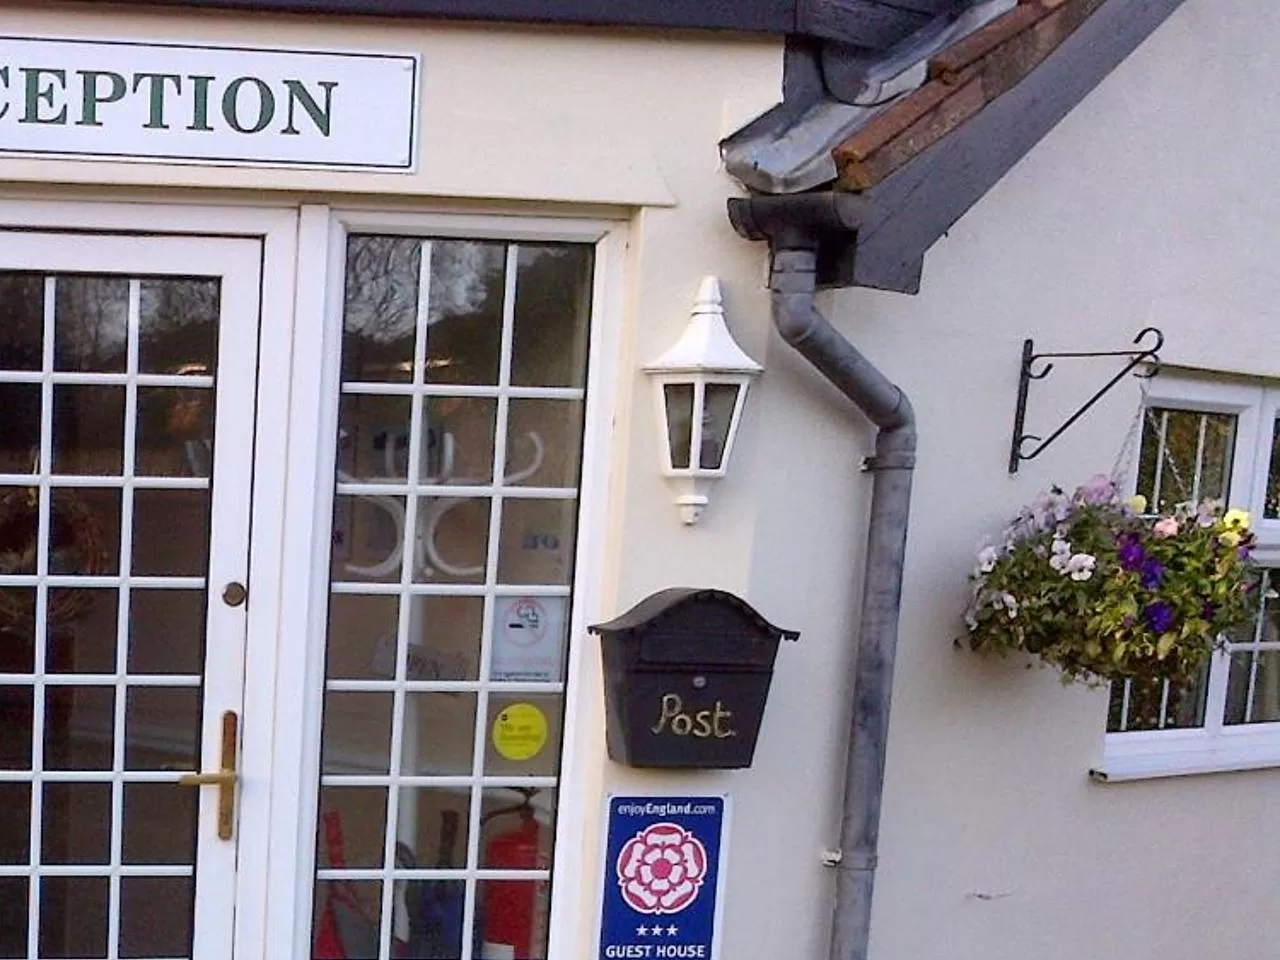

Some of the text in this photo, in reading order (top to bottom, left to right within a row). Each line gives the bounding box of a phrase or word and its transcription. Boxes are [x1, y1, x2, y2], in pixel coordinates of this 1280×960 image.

[651, 694, 736, 738] Post
[617, 803, 715, 816] enjoyEngland.com
[605, 945, 705, 958] GUEST HOUSE
